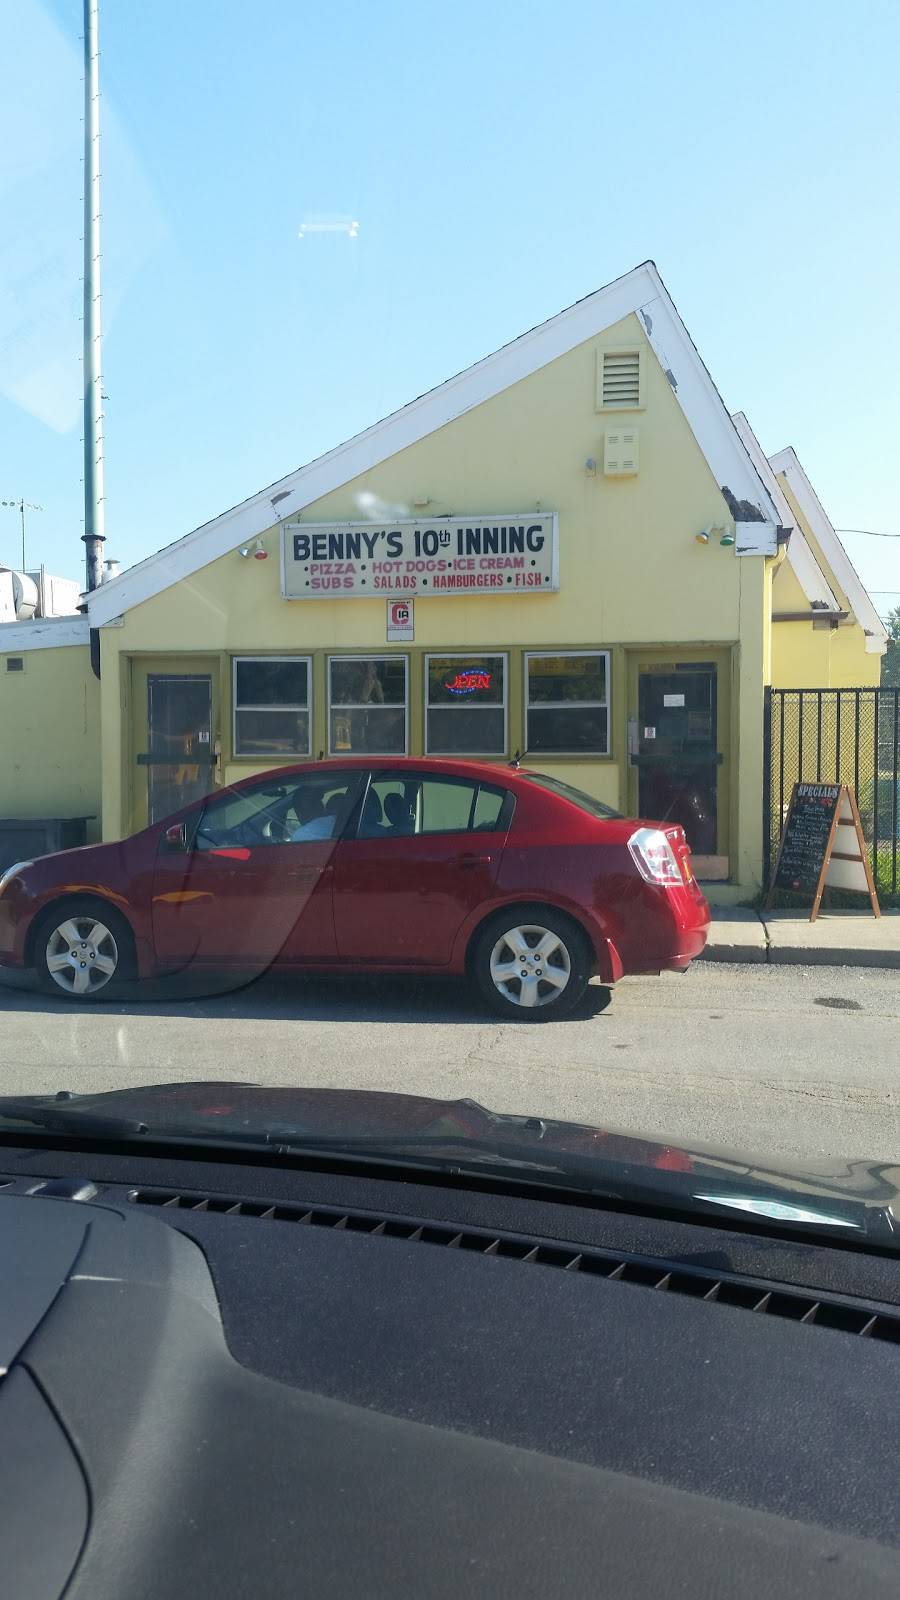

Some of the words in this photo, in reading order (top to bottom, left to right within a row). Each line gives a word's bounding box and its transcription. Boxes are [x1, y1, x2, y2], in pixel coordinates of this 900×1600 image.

[293, 530, 404, 560] BENNY'S
[457, 525, 545, 555] INNING
[310, 562, 356, 575] PIZZA
[372, 561, 403, 573] HOT
[406, 559, 447, 573] DOGS
[452, 558, 475, 571] ICE
[479, 556, 525, 570] CREAM
[311, 577, 354, 589] SUBS
[373, 575, 417, 589] SALADS
[432, 573, 504, 588] HAMBURGERS
[515, 572, 542, 586] FISH
[797, 784, 839, 798] SPECIALS
